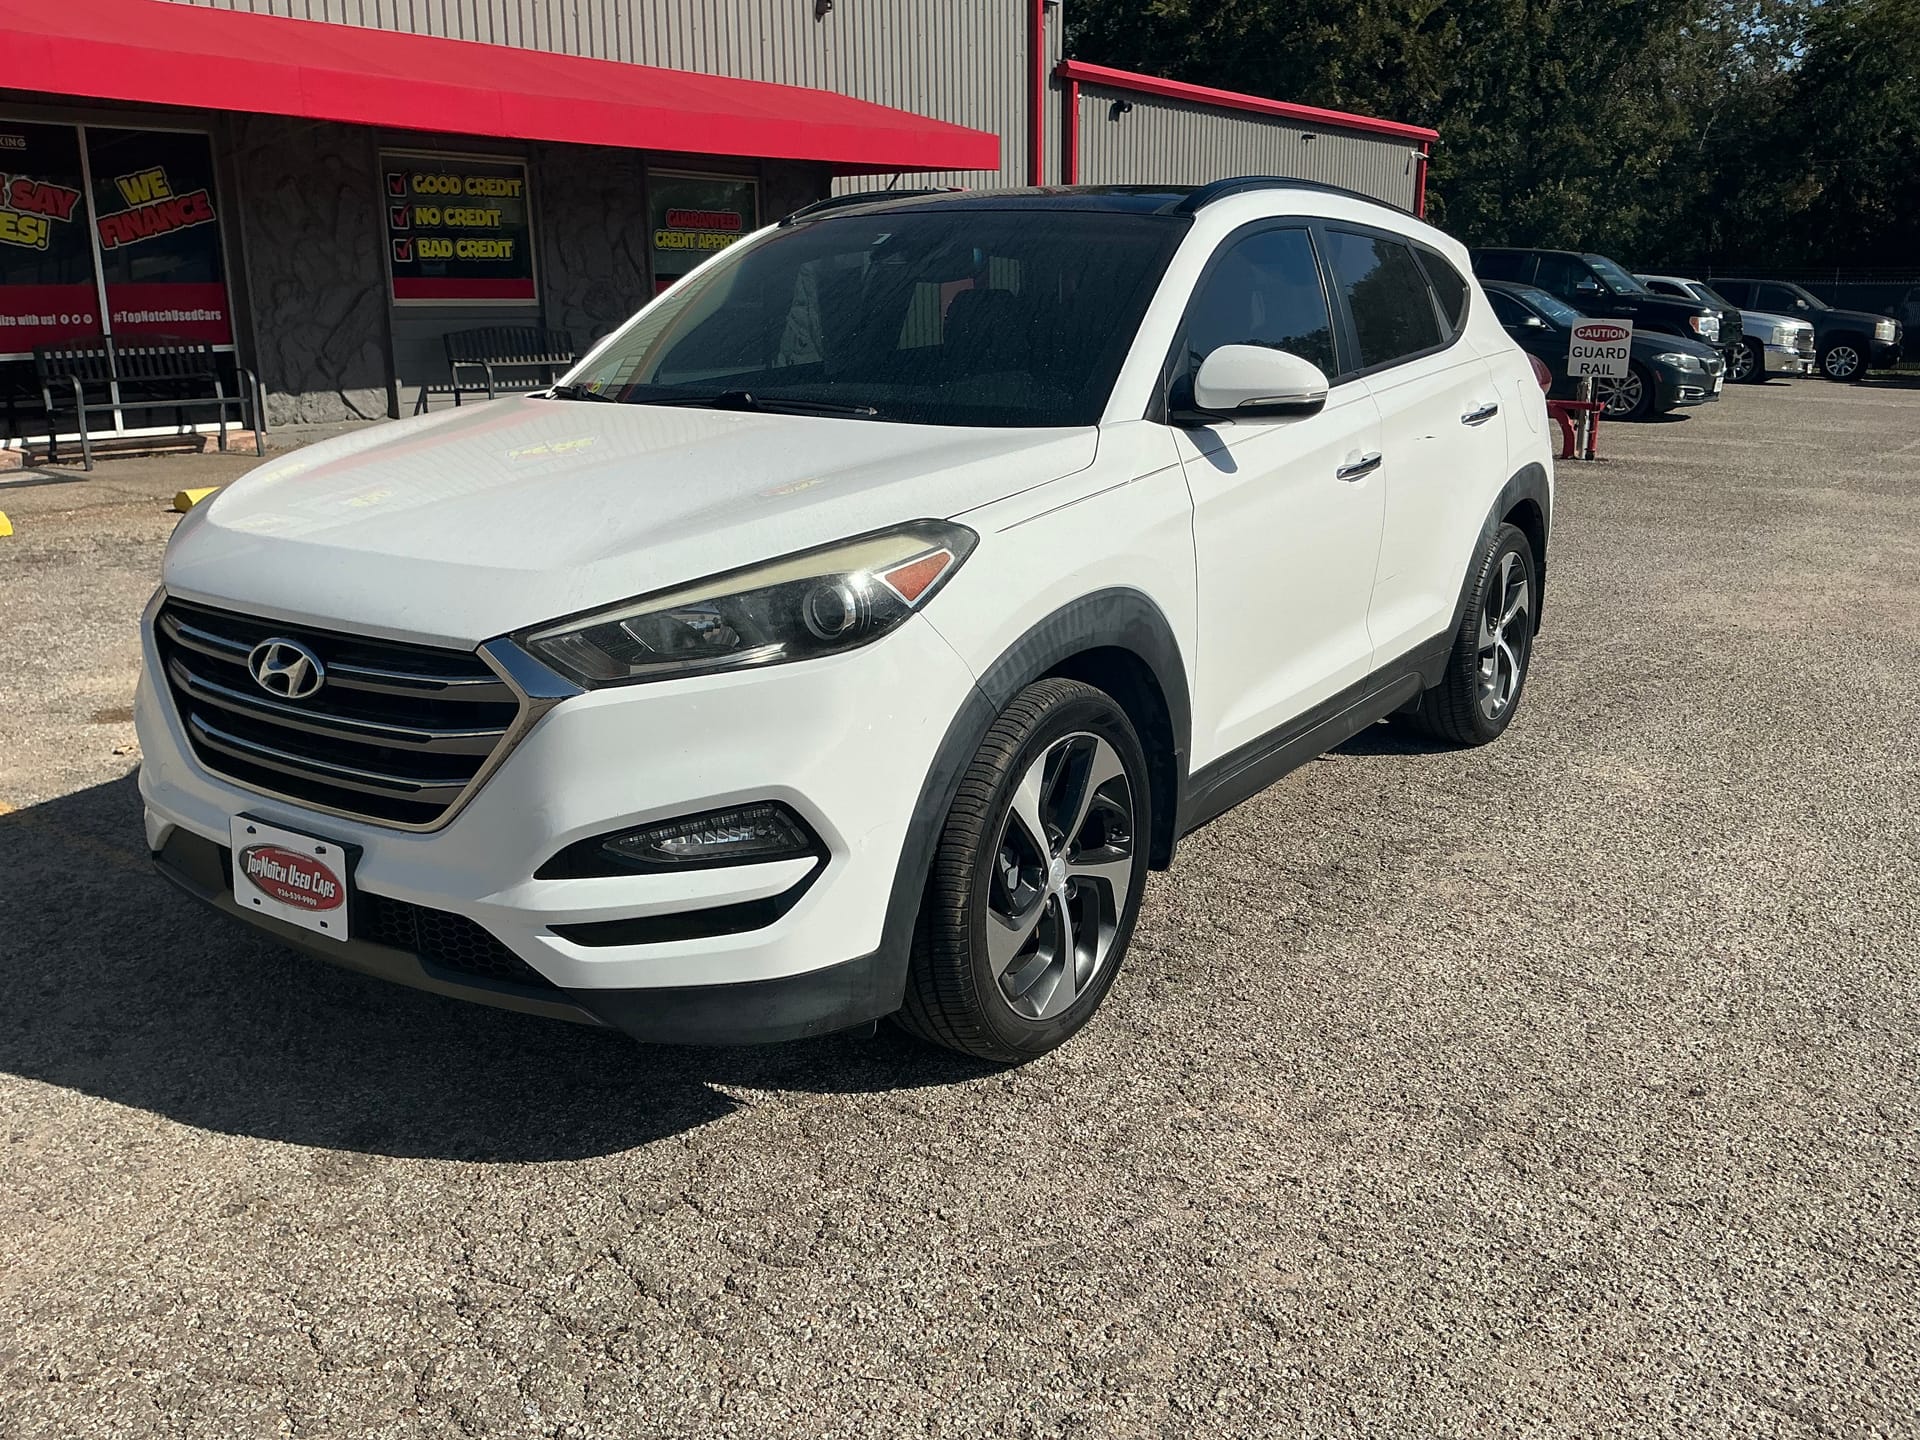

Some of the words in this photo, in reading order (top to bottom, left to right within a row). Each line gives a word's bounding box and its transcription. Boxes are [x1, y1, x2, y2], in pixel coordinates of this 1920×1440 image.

[117, 168, 171, 205] WE
[412, 174, 462, 194] GOOD
[465, 178, 522, 197] CREDIT
[10, 178, 80, 220] SAY
[98, 190, 214, 249] FINANCE
[415, 207, 441, 226] NO
[444, 208, 501, 227] CREDIT
[668, 210, 740, 230] GUARANTEED
[417, 239, 453, 258] BAD
[456, 240, 513, 259] CREDIT
[655, 231, 696, 249] CREDIT
[698, 233, 740, 249] APPRO
[17, 313, 40, 326] with
[40, 313, 57, 326] us!
[113, 308, 222, 324] #TopNotchUsedCars
[1577, 328, 1626, 339] CAUTION
[1572, 346, 1627, 359] GUARD
[1580, 362, 1615, 376] RAIL
